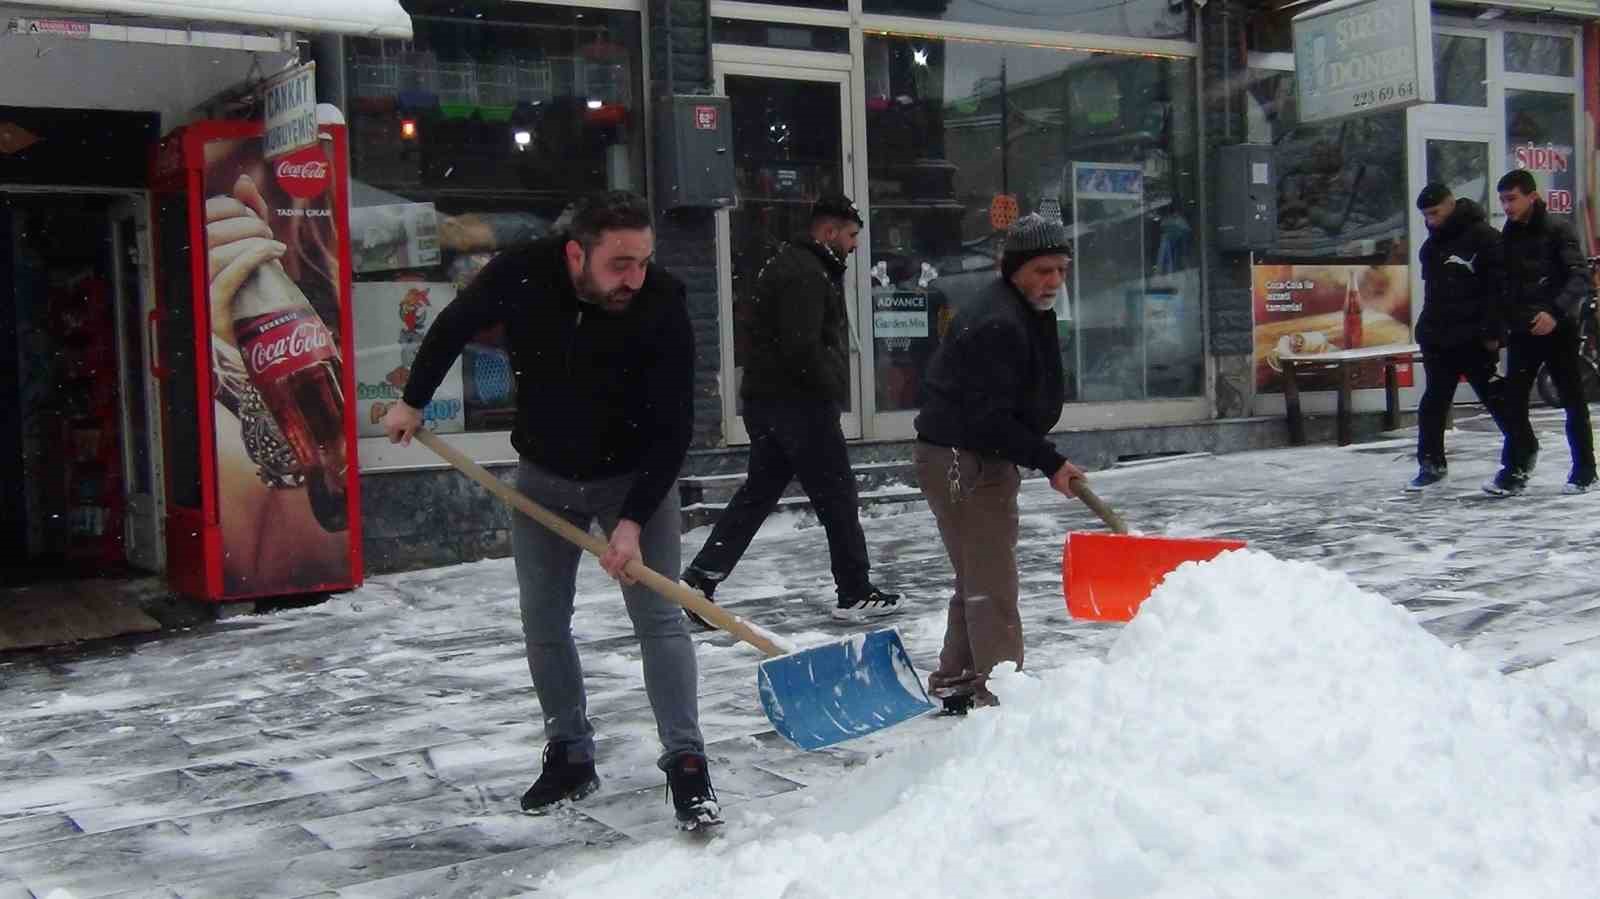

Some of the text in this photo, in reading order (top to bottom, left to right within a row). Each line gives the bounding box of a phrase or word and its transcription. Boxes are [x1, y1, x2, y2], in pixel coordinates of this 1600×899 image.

[1352, 81, 1414, 107] 223 69 64
[277, 160, 328, 178] Coca-Cola
[877, 296, 926, 307] ADVANCE
[251, 322, 327, 374] Coca-Cola
